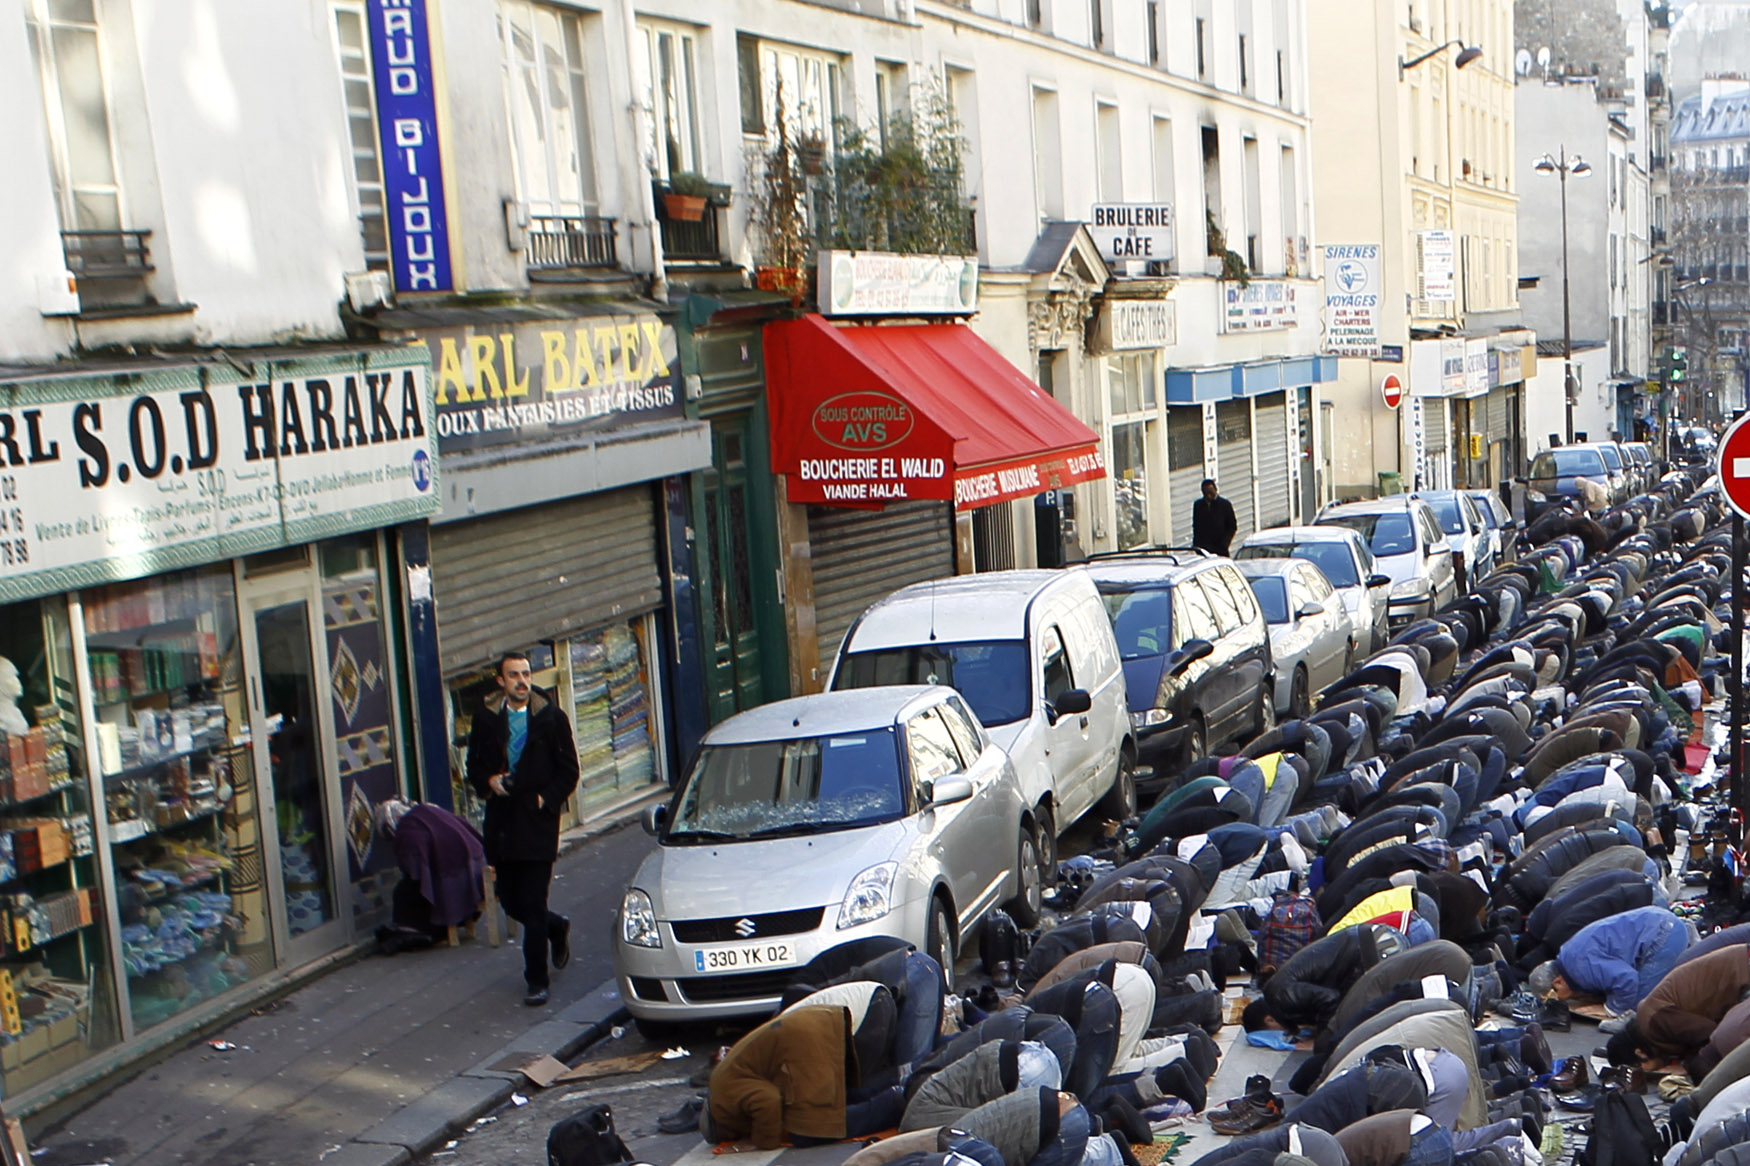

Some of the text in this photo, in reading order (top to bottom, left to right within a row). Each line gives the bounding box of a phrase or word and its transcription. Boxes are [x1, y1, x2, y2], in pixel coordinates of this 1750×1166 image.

[381, 0, 437, 290] AUD BIJOUX
[1095, 207, 1169, 226] BRULERIE
[1325, 246, 1377, 259] SIRENES
[1326, 295, 1377, 307] VOYAGES
[1333, 318, 1371, 326] CHARTERS
[1346, 337, 1378, 345] MECQUE
[540, 321, 671, 393] BATEX
[615, 385, 675, 413] TISSUS
[820, 404, 905, 422] SOUS CONTRÔLE
[73, 391, 221, 488] S.O.D
[239, 370, 425, 461] HARAKA
[842, 422, 887, 442] AVS
[800, 458, 945, 480] BOUCHERIE EL WALID
[822, 483, 908, 499] VIANDE HALAL
[955, 473, 999, 503] BOUCHERIE
[35, 521, 72, 542] Vente
[75, 516, 90, 535] de
[708, 945, 788, 967] 330 YK 02
